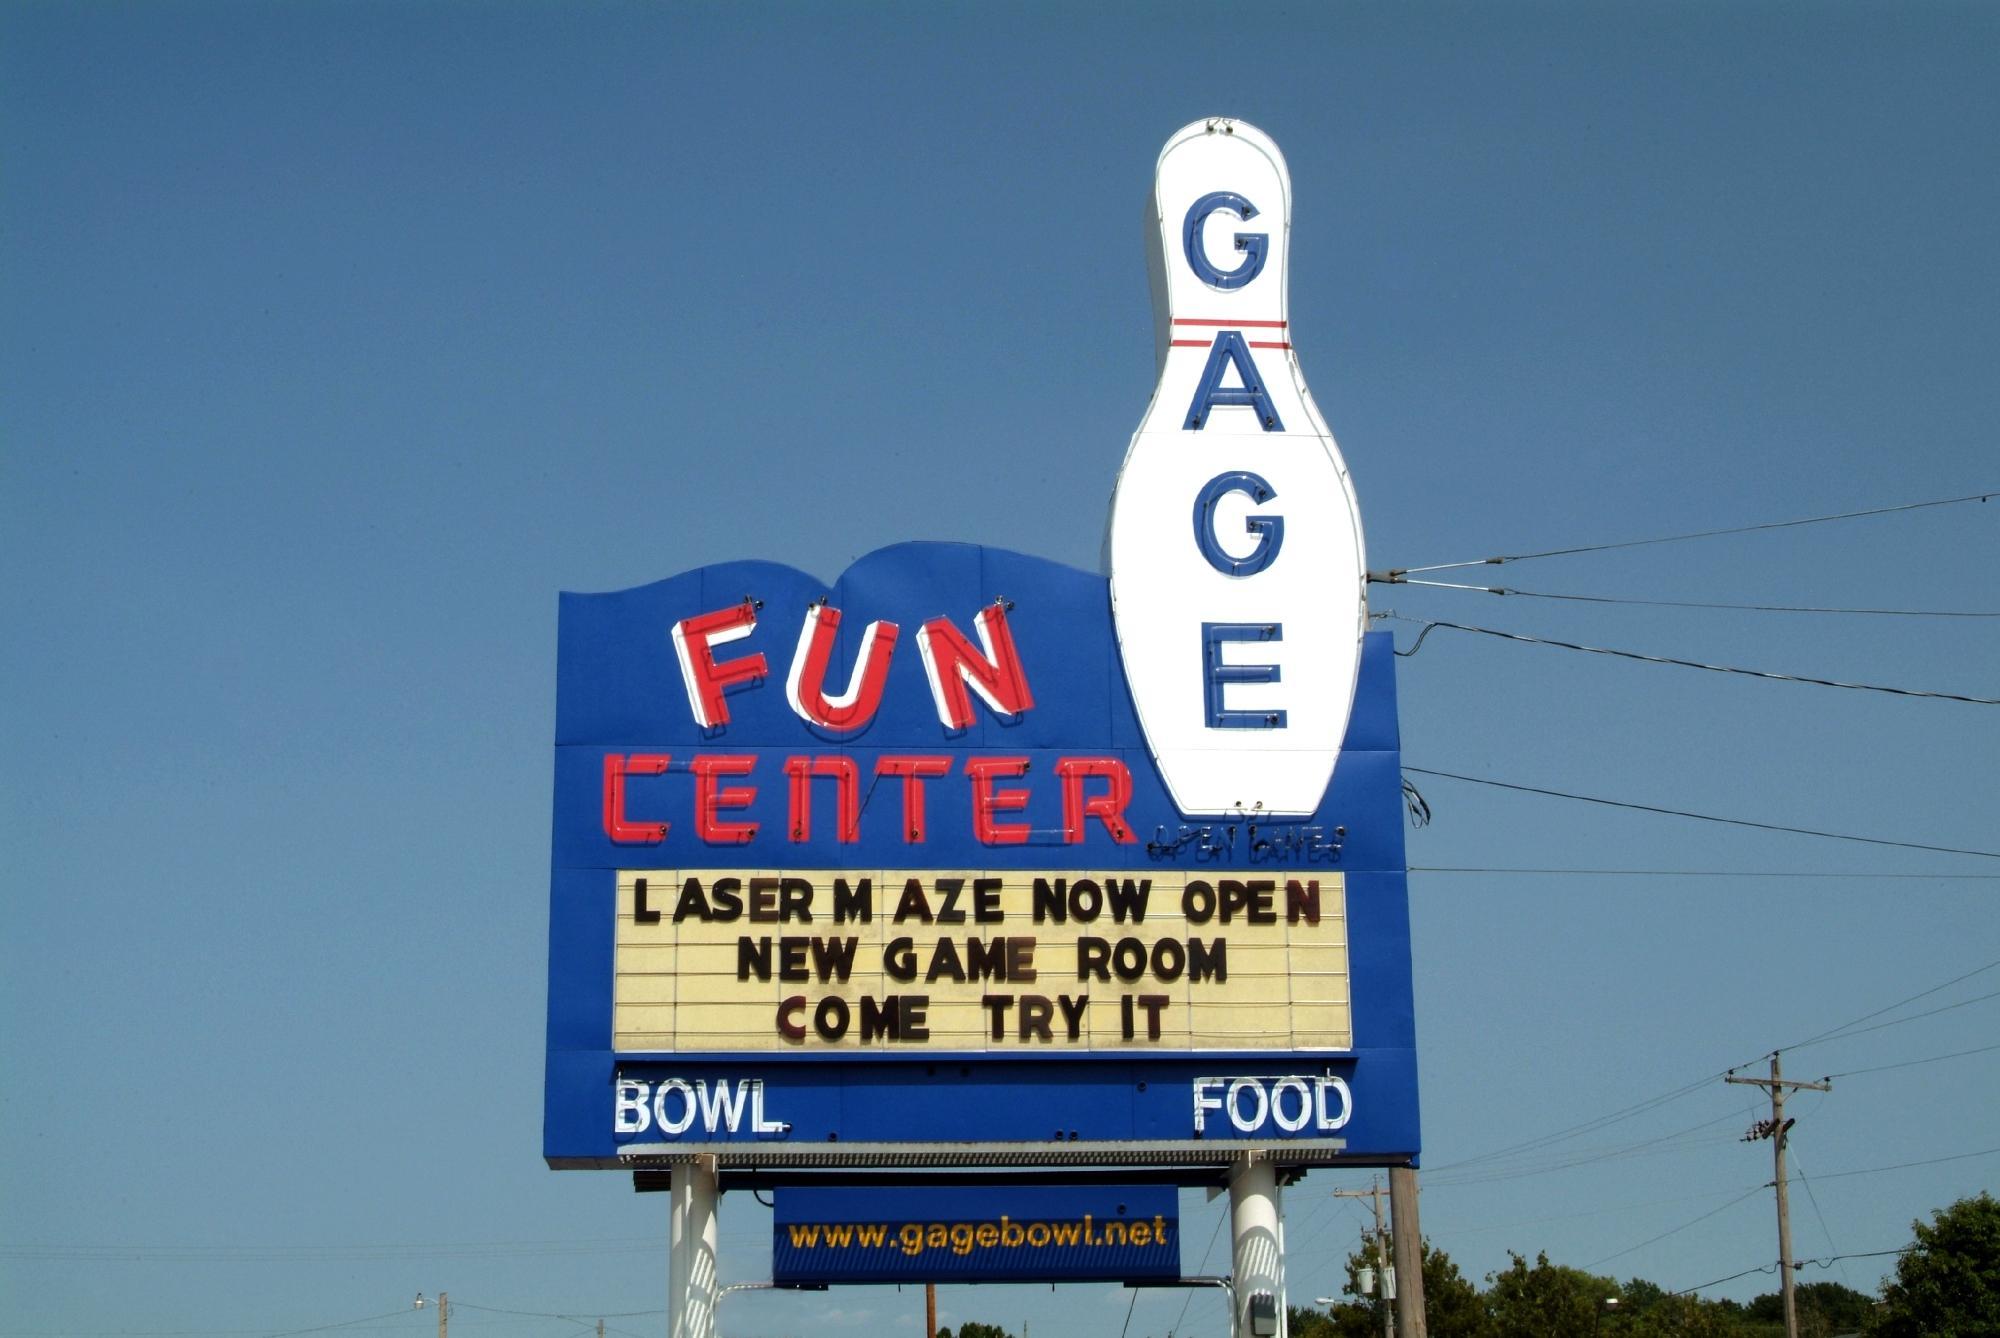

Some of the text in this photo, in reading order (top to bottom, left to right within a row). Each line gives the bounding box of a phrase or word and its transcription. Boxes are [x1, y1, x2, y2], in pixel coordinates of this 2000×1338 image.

[1182, 190, 1287, 729] GAGE
[671, 602, 1033, 731] FUN
[604, 753, 1139, 845] CENTER
[634, 878, 814, 924] LASER
[1033, 878, 1152, 923] NOW
[1182, 879, 1321, 924] OPEN
[737, 936, 1228, 983] NEW GAME ROOM
[776, 994, 1170, 1041] COME TRY IT
[614, 1077, 785, 1134] BOWL
[1193, 1076, 1354, 1133] FOOD
[788, 1214, 1167, 1256] www.gagebowl.net
